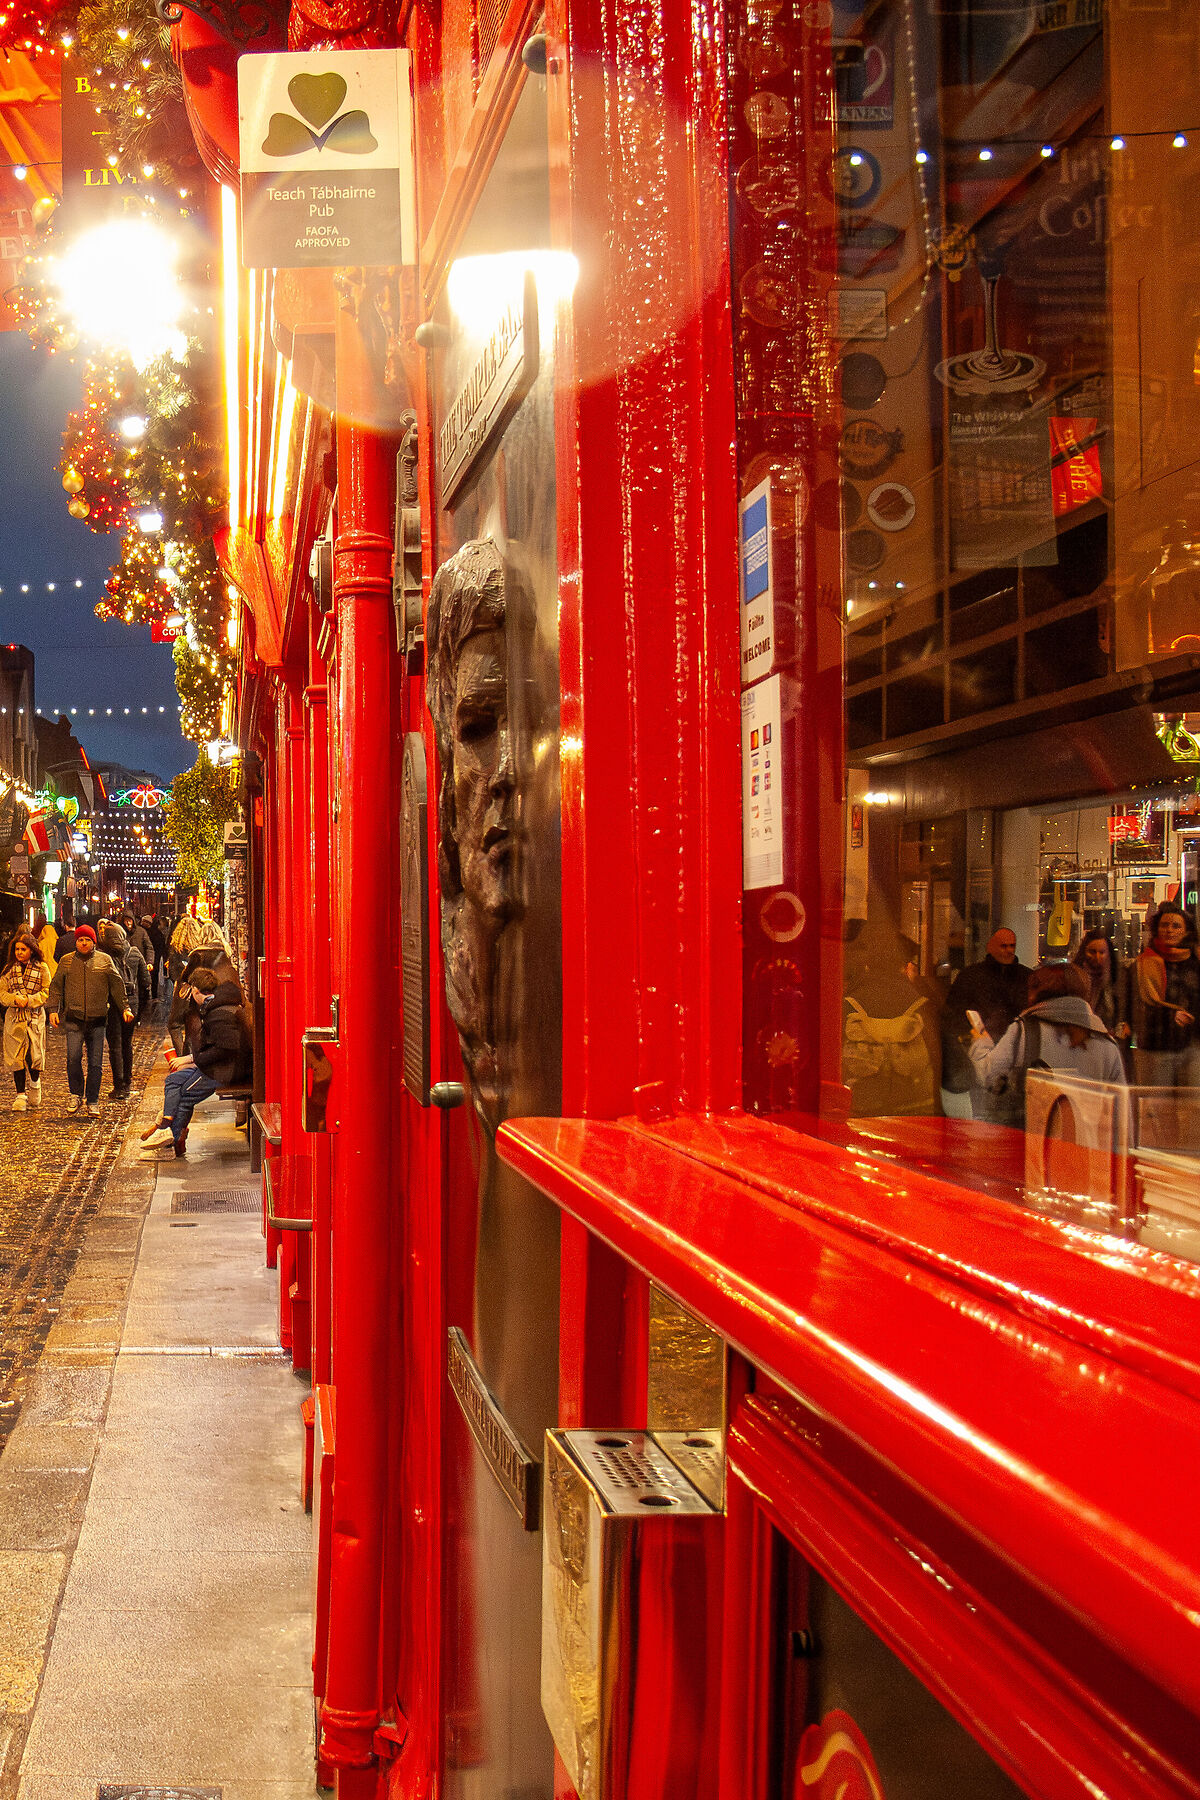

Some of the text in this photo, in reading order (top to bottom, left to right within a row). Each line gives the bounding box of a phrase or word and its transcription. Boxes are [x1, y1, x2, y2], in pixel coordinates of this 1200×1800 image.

[266, 186, 376, 201] Teach Tábhairne
[309, 203, 334, 217] Pub
[305, 226, 339, 236] FAOFA
[294, 237, 351, 249] APPROVED
[743, 636, 771, 665] WELCOME
